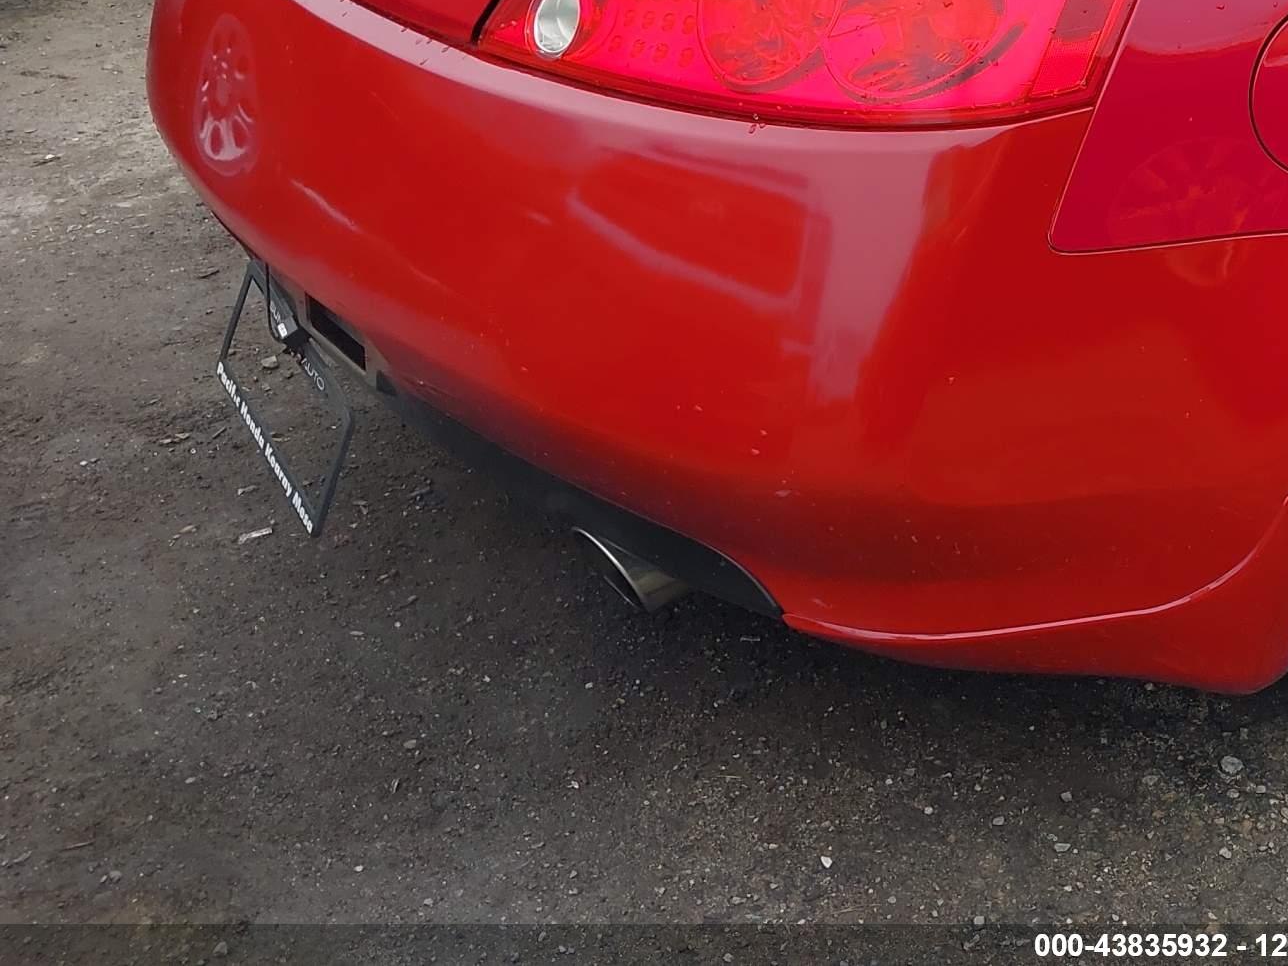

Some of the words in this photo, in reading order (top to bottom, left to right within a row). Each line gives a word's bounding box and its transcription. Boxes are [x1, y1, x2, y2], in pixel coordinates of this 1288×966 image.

[216, 361, 241, 407] Pacific
[240, 401, 265, 449] Honda
[292, 491, 313, 534] Mesa
